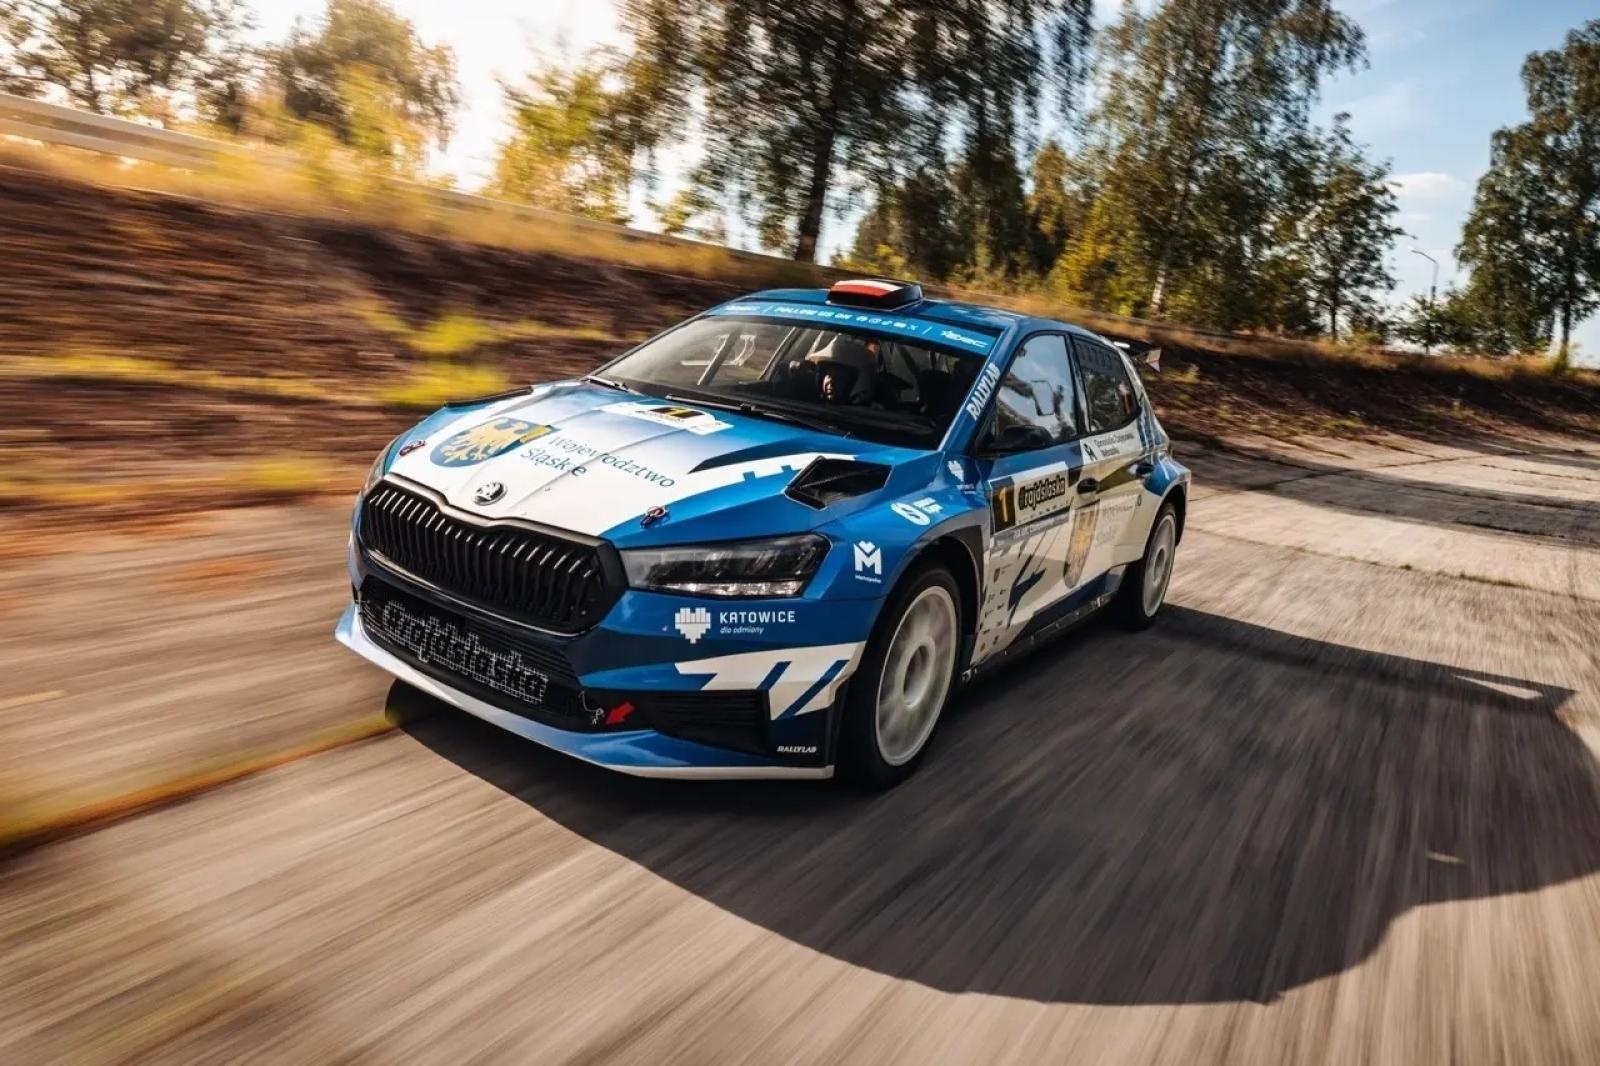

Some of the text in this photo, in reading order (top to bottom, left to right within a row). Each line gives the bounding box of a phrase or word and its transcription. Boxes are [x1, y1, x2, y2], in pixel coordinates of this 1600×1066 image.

[966, 363, 1000, 420] RALLYLAB
[998, 487, 1009, 523] 1
[719, 611, 796, 624] KATOWICE
[719, 625, 765, 635] dla odmiany
[777, 745, 817, 753] RALLYLAB
